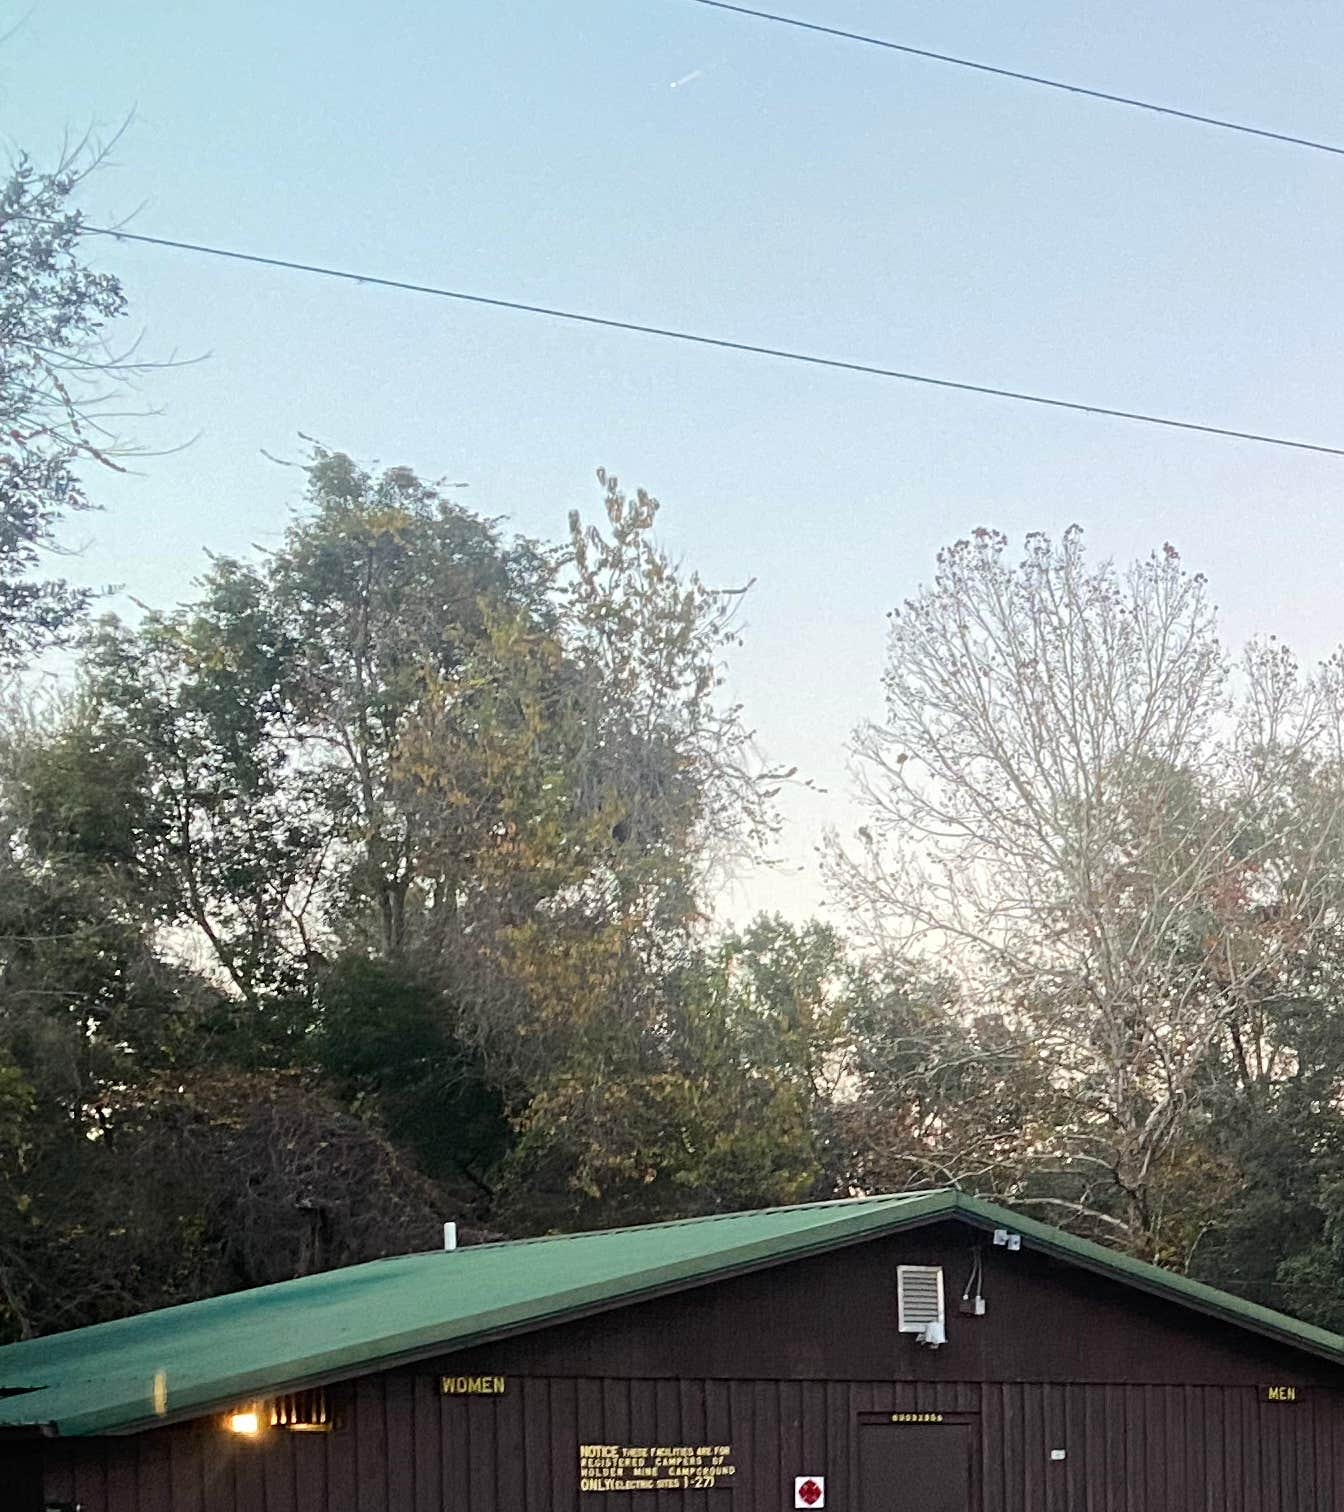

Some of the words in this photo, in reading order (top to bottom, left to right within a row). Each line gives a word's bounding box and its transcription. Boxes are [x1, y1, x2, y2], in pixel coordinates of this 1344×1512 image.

[441, 1377, 505, 1394] WOMEN
[1268, 1386, 1296, 1400] MEN
[580, 1445, 619, 1458] NOTICE
[580, 1457, 645, 1467] REGISTERED
[655, 1456, 702, 1467] CAMPERS
[580, 1467, 624, 1477] HOLDER
[633, 1466, 659, 1477] MINE
[668, 1465, 736, 1477] CAMPGROUND
